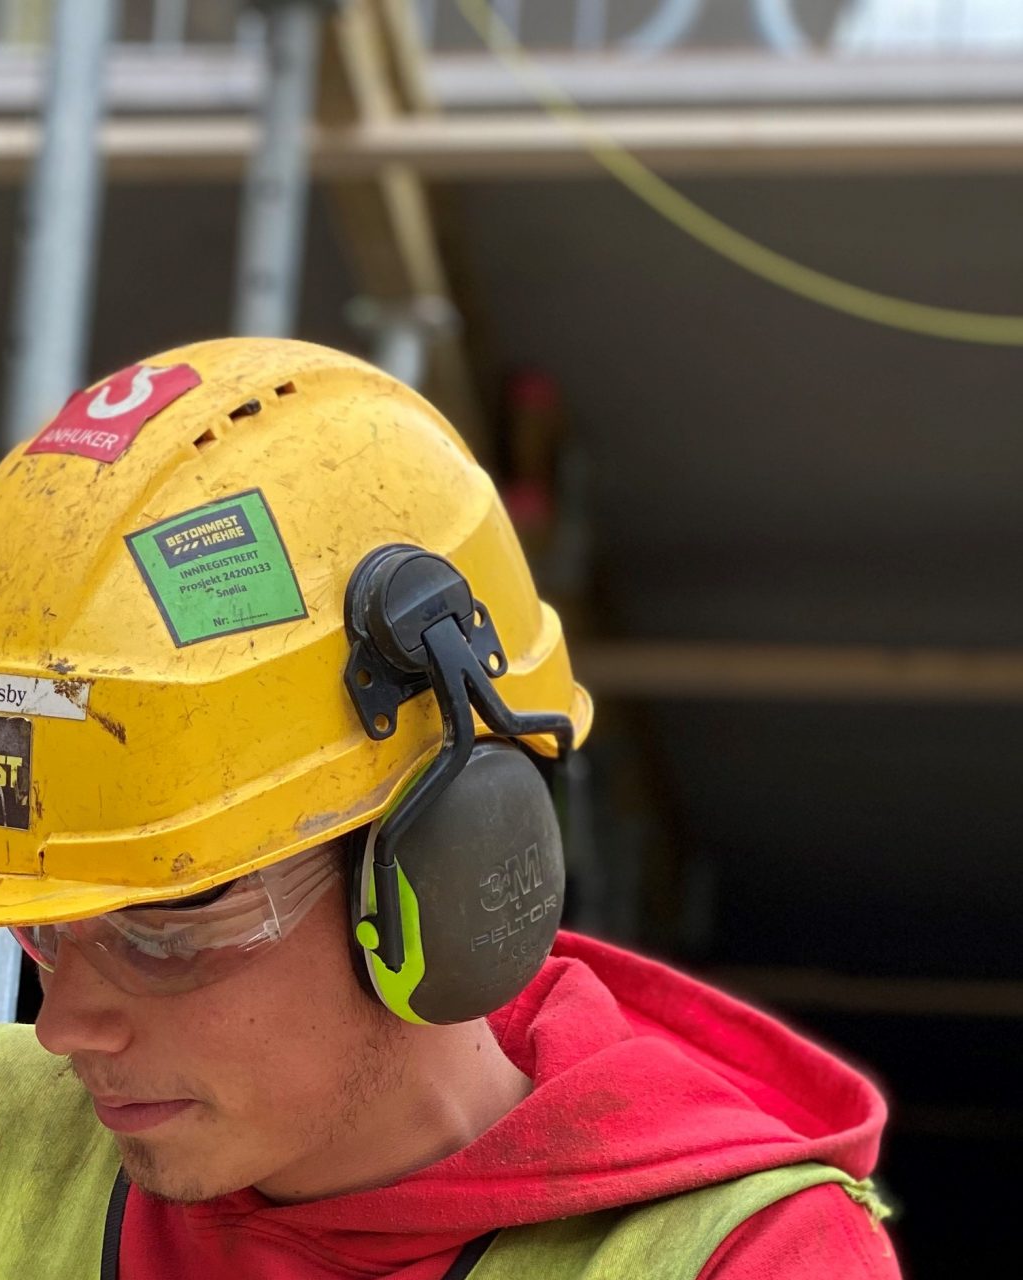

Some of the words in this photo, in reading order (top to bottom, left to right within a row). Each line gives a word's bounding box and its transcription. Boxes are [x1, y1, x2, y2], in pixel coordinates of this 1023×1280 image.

[165, 515, 238, 547] BETONMAST
[201, 525, 245, 546] HÆHRE
[179, 575, 222, 594] Prosjekt
[222, 562, 272, 581] 24200133
[180, 550, 258, 579] INNREGISTRERT
[216, 584, 248, 598] Snølia
[213, 617, 230, 627] Nr:
[479, 843, 543, 912] 3M
[471, 894, 557, 952] PELTOR
